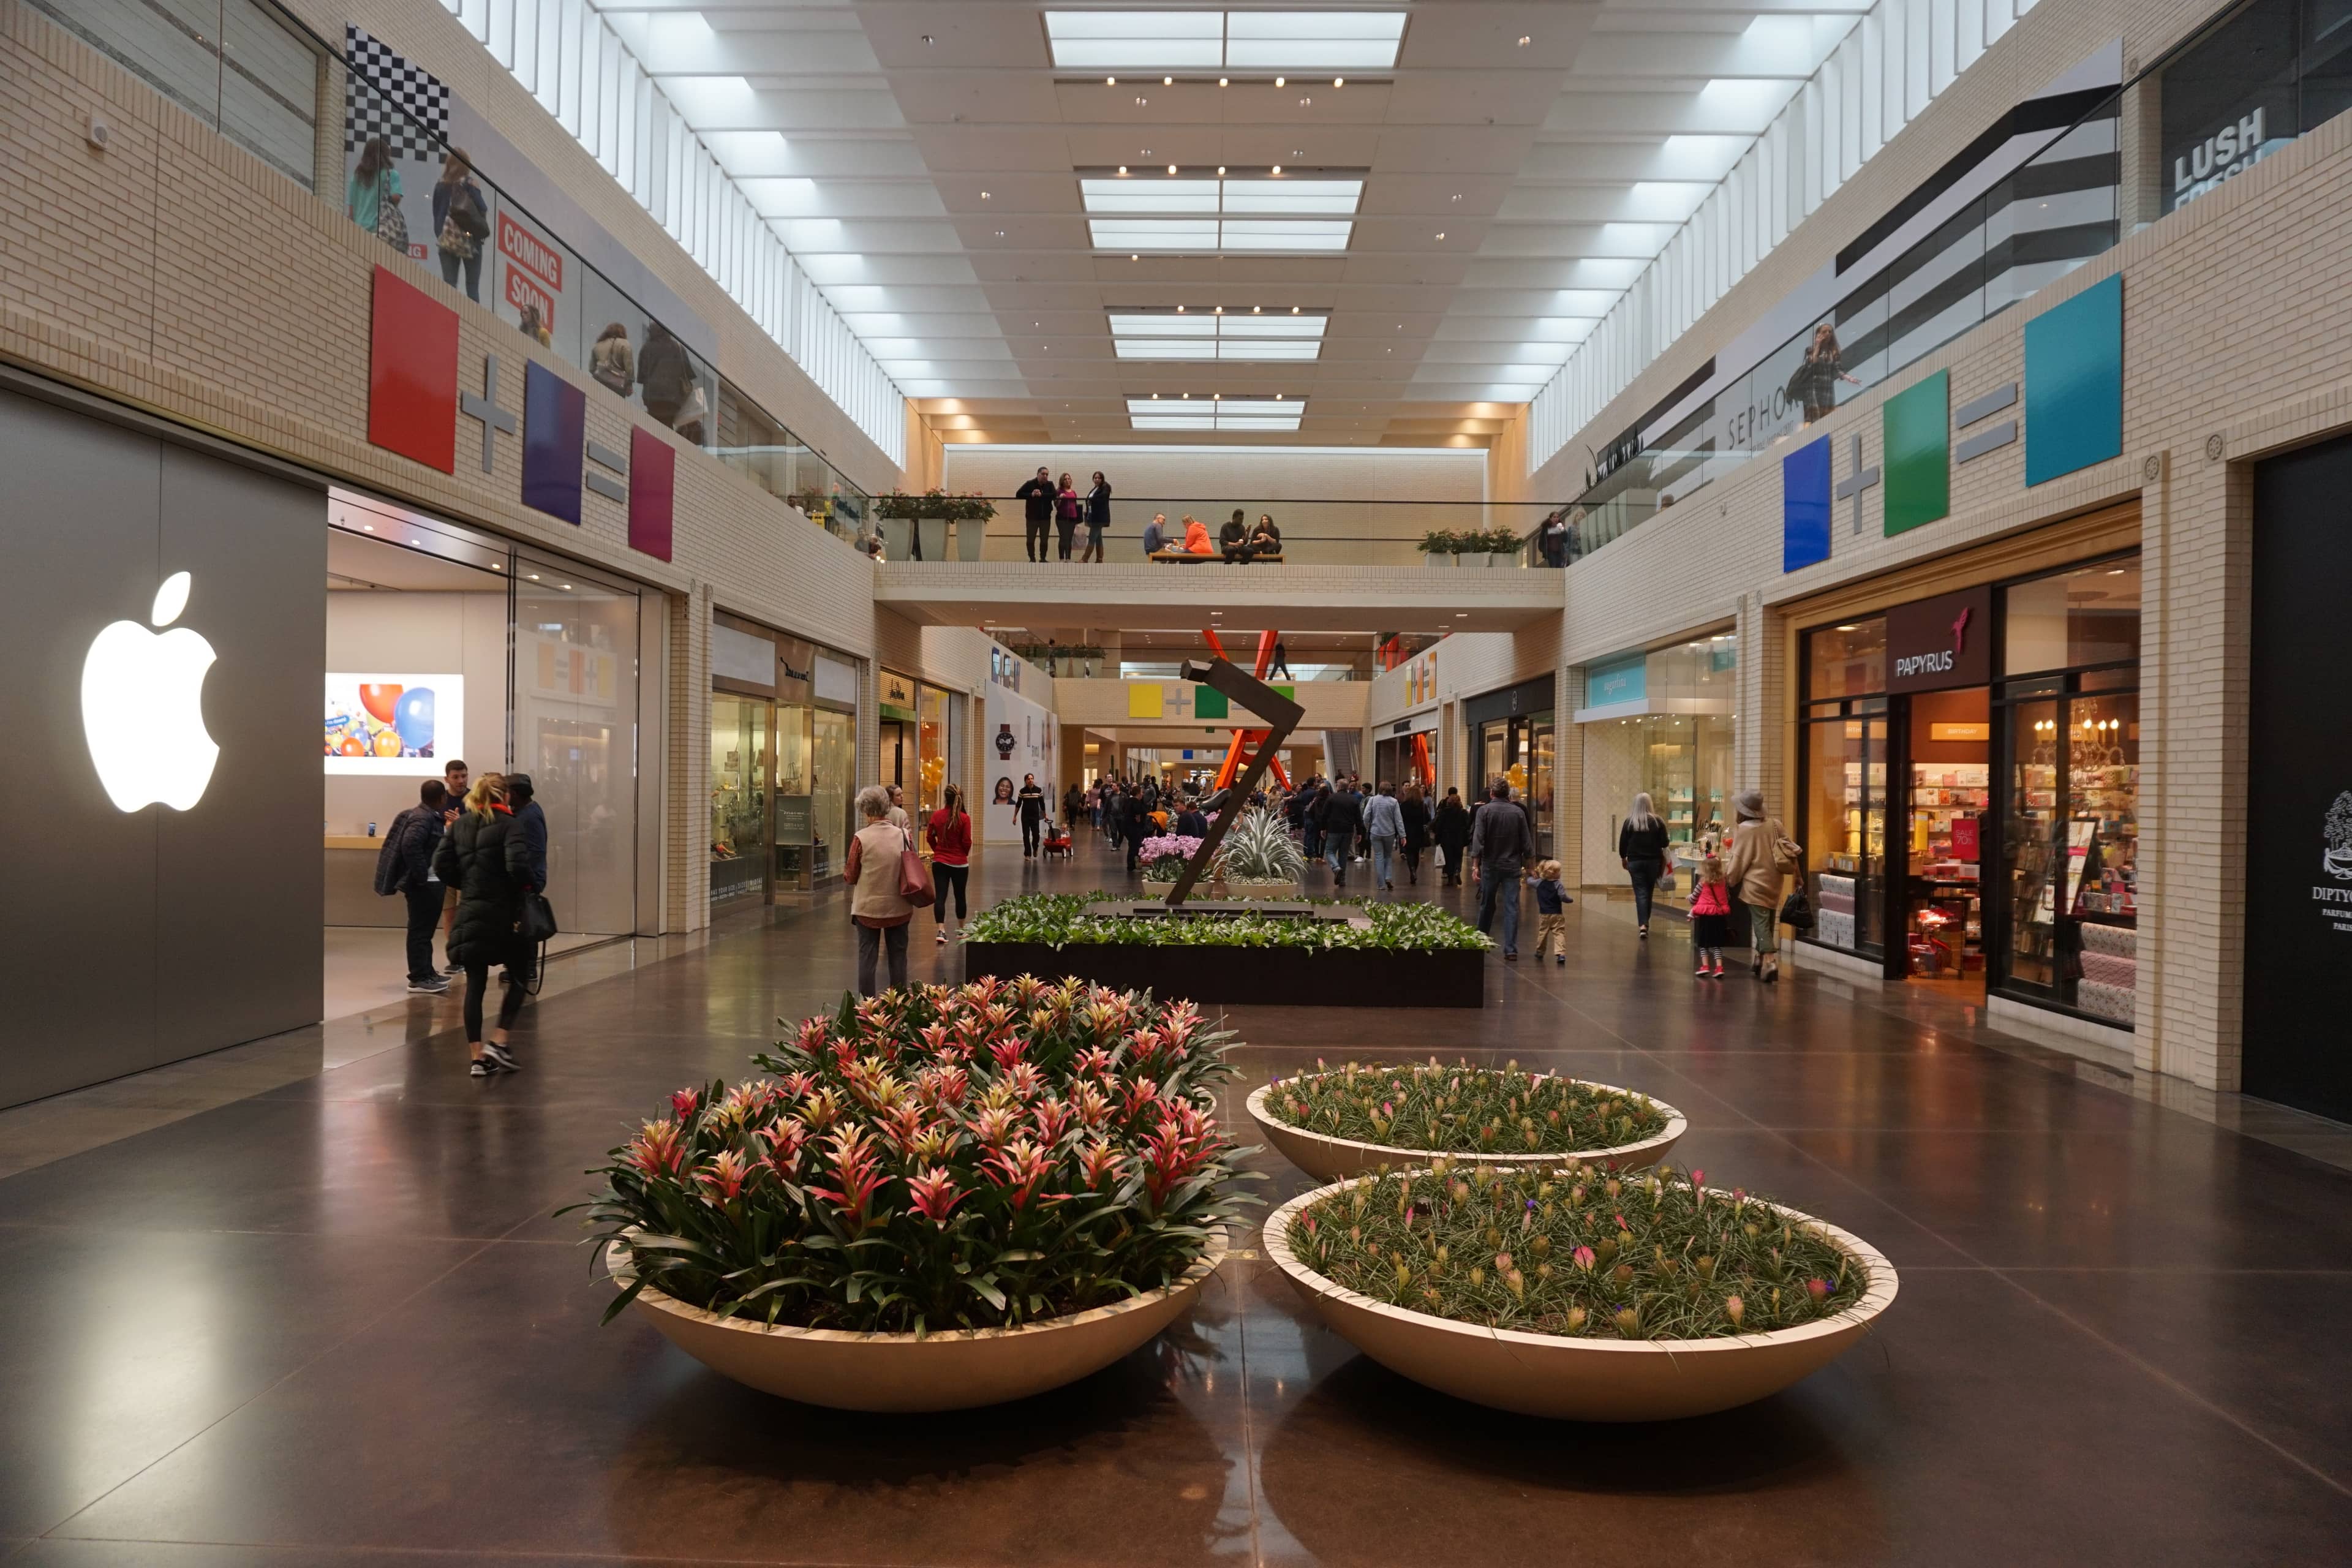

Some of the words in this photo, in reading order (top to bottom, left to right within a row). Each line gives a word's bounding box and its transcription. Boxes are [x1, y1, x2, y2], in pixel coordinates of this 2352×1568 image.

[2175, 107, 2266, 193] LUSH
[504, 222, 557, 284] COMING
[511, 273, 549, 325] SOON
[1728, 385, 1800, 451] SEPHO
[1896, 650, 1953, 677] PAPYRUS
